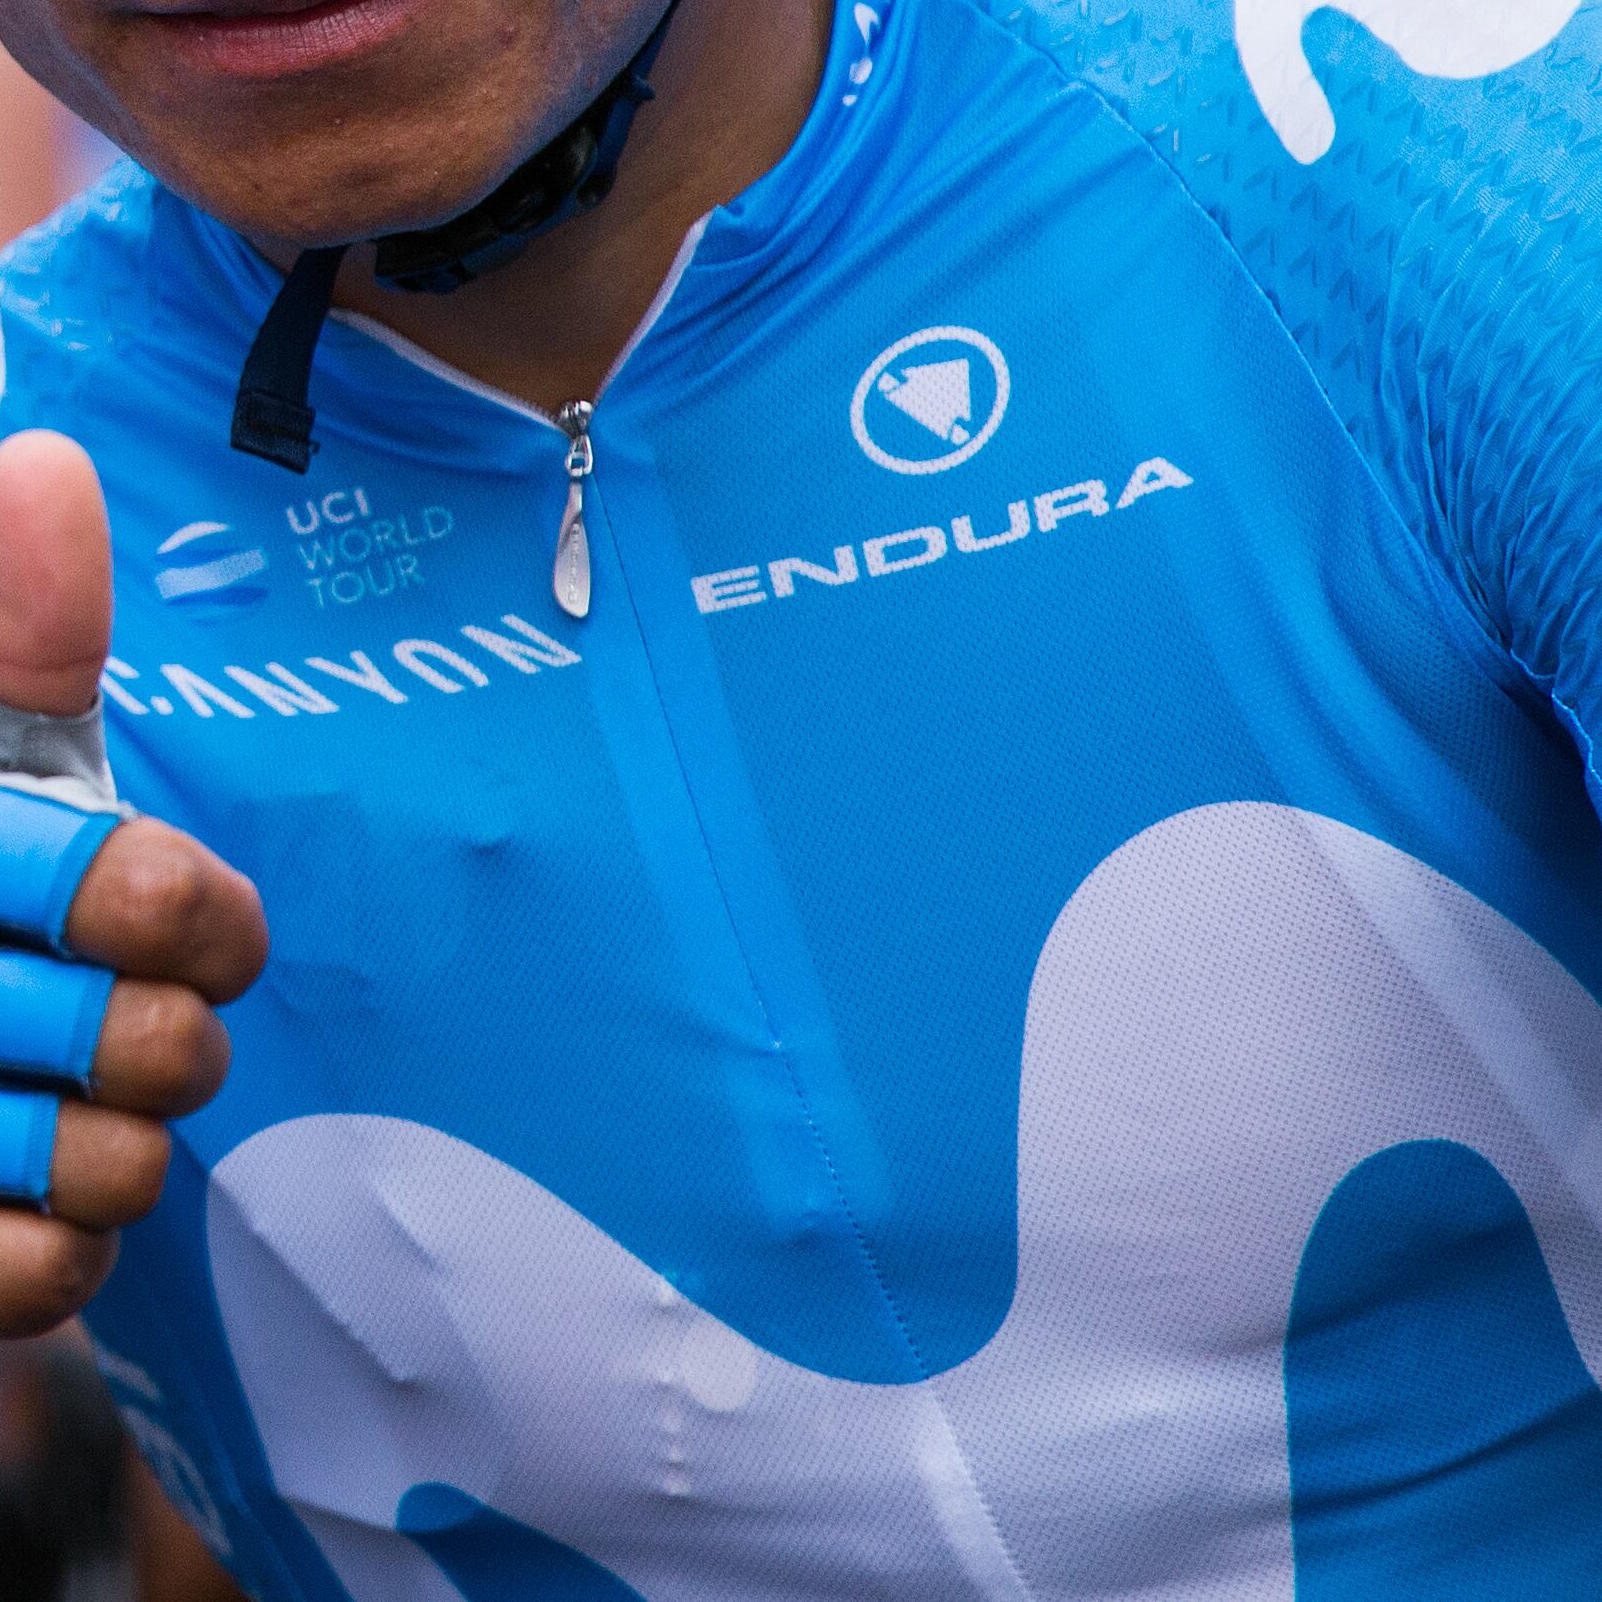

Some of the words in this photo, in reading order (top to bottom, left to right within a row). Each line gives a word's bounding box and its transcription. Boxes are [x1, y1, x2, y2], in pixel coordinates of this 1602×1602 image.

[285, 486, 372, 536] UCI
[297, 506, 454, 571] WORLD
[691, 455, 1195, 616] ENDURA
[307, 552, 427, 609] TOUR
